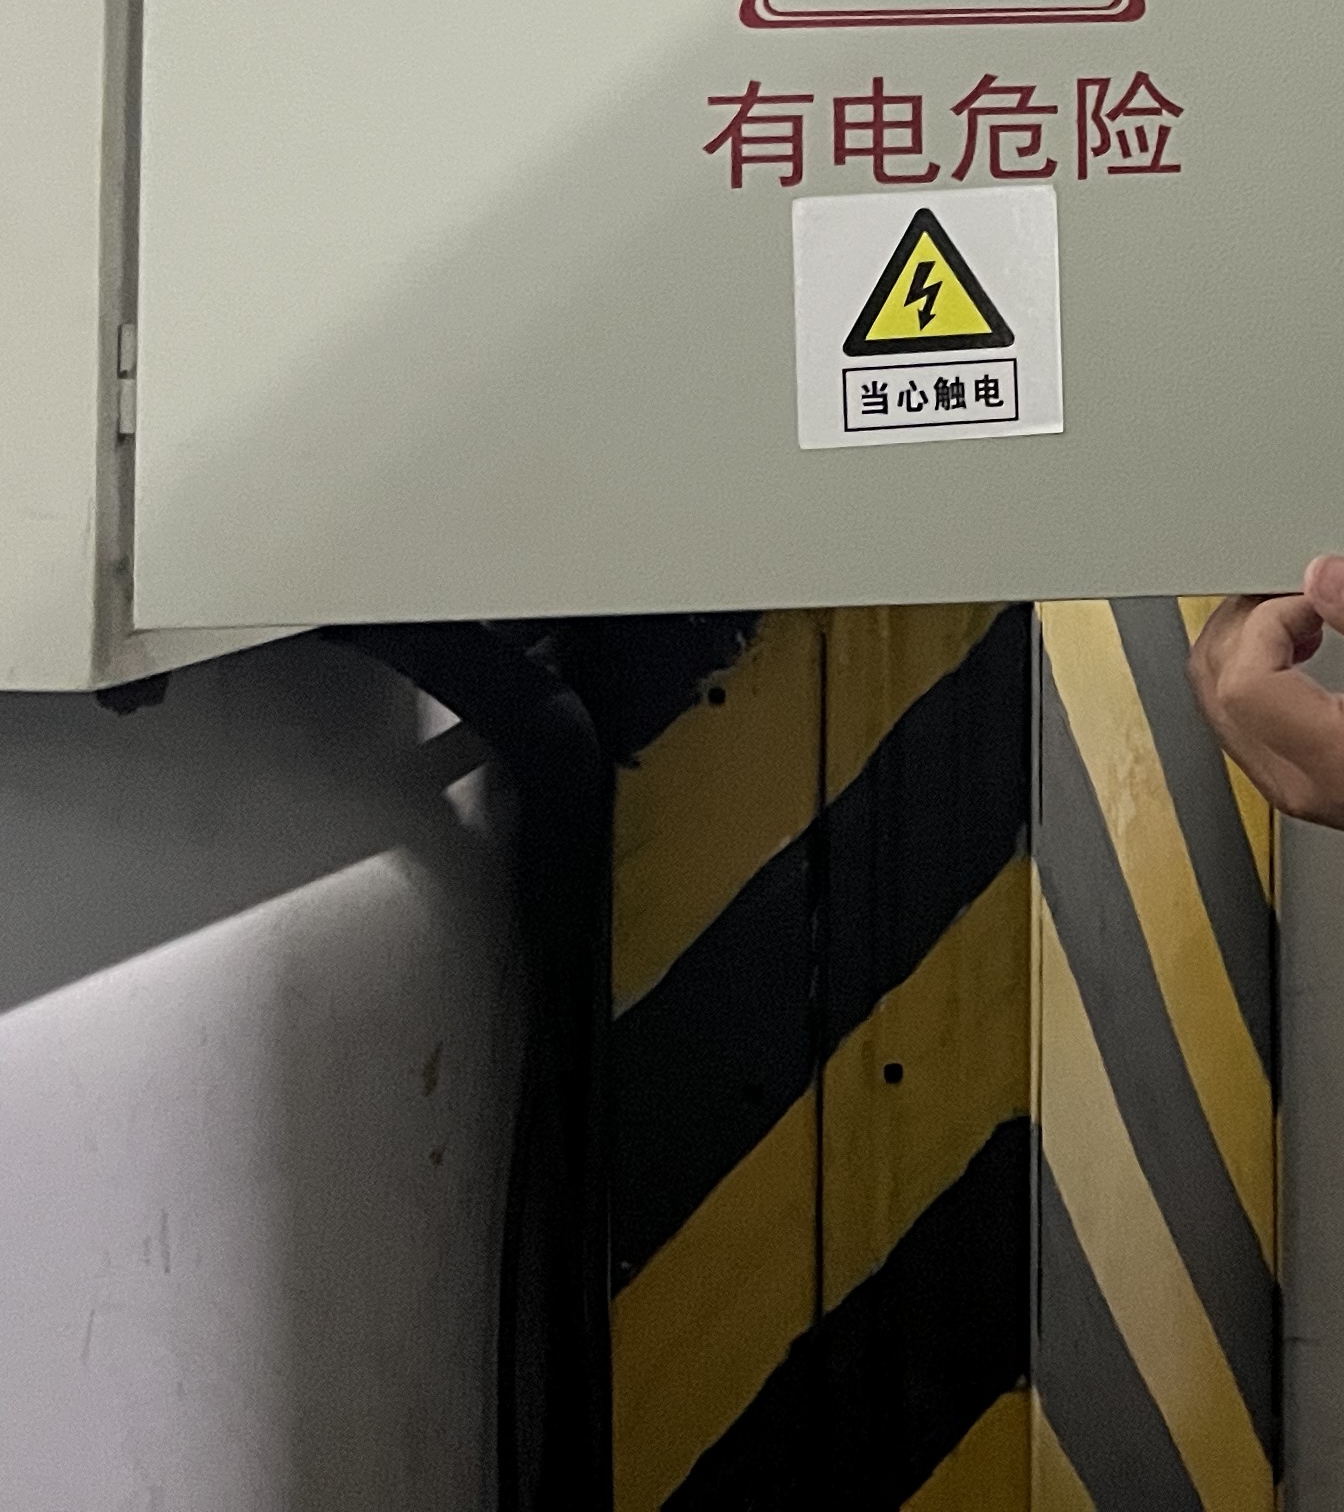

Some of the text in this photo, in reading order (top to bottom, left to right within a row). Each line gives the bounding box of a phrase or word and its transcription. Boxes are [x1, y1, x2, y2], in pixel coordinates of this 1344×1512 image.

[703, 70, 1186, 190] 有电危险
[860, 374, 1005, 418] 当心触电
